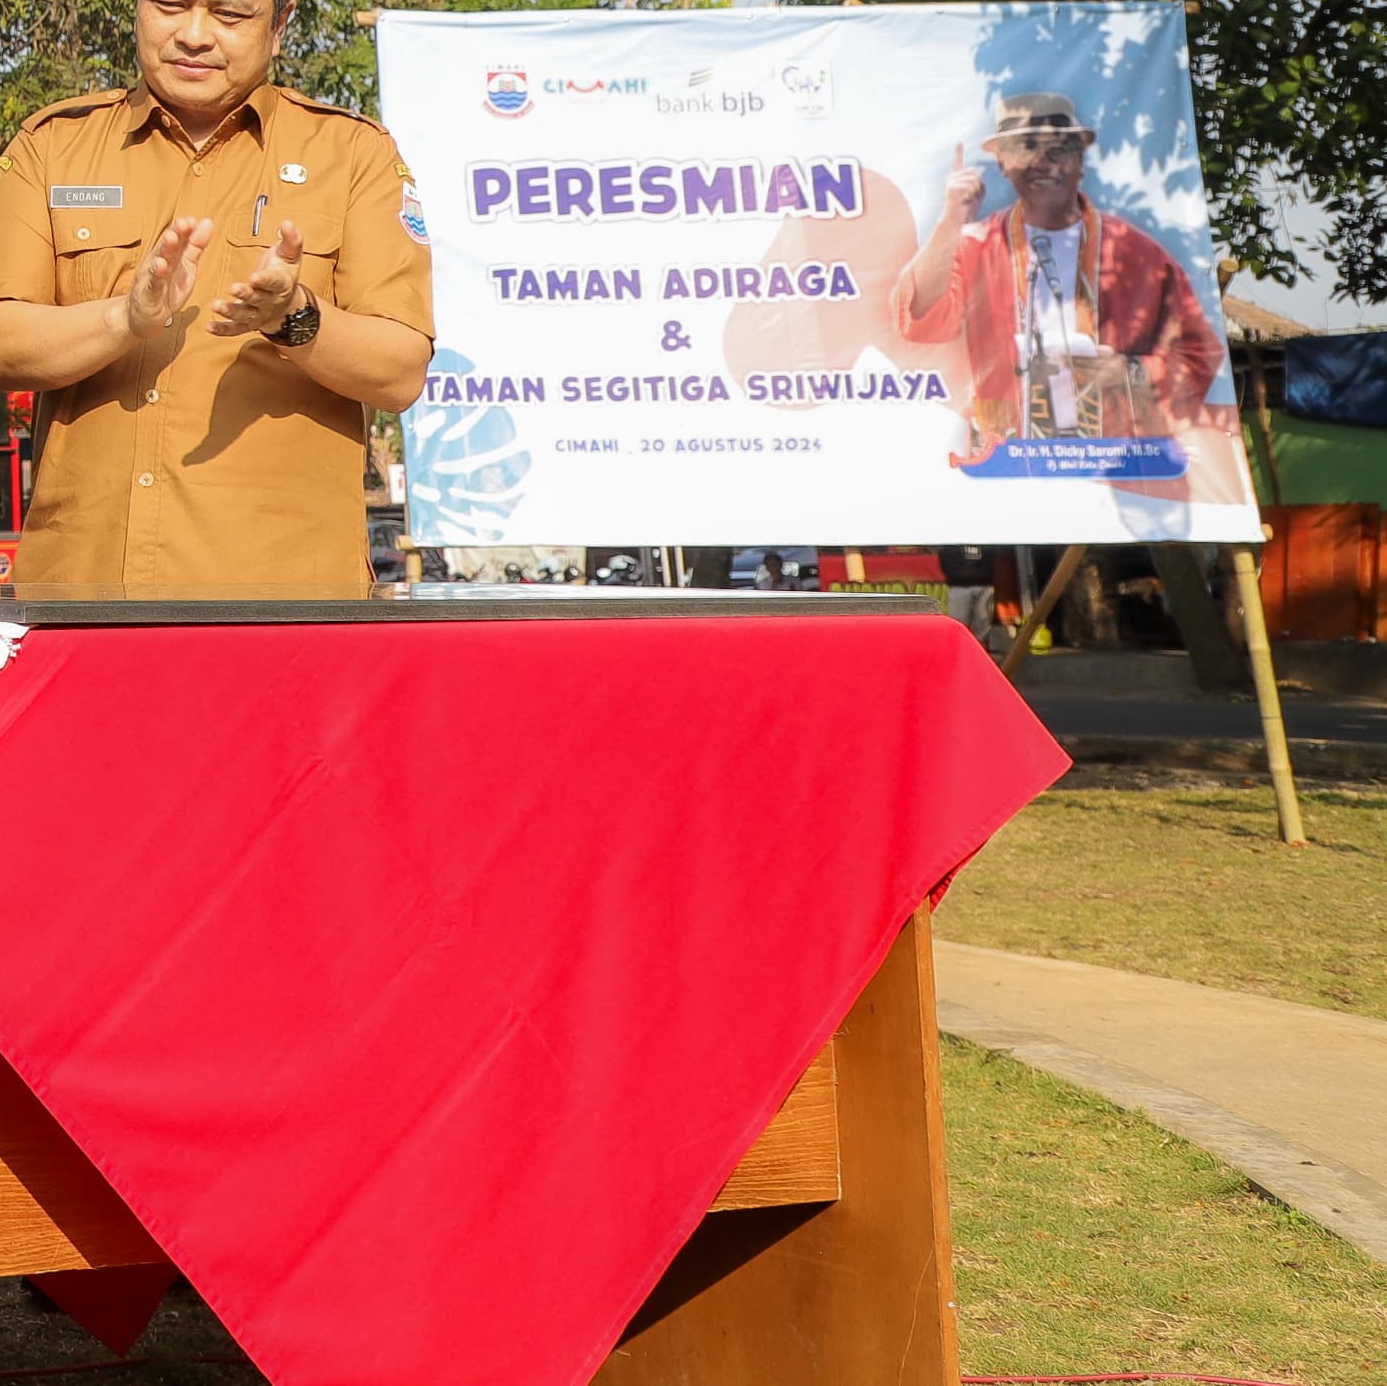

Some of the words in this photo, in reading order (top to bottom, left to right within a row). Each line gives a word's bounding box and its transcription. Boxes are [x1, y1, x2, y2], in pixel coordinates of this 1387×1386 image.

[656, 94, 714, 114] bank
[722, 92, 764, 116] bjb
[66, 191, 105, 202] ENDANG
[471, 163, 858, 217] PERESMIAN
[491, 268, 643, 301] TAMAN
[662, 265, 858, 300] ADIRAGA
[660, 320, 693, 352] &
[425, 375, 545, 403] TAMAN
[562, 374, 730, 403] SEGITIGA
[747, 372, 947, 402] SRIWIJAYA
[554, 438, 619, 453] CIMAHI
[640, 439, 665, 453] 20
[675, 437, 765, 453] AGUSTUS
[773, 437, 823, 452] 2024
[1008, 445, 1026, 458] Dr.
